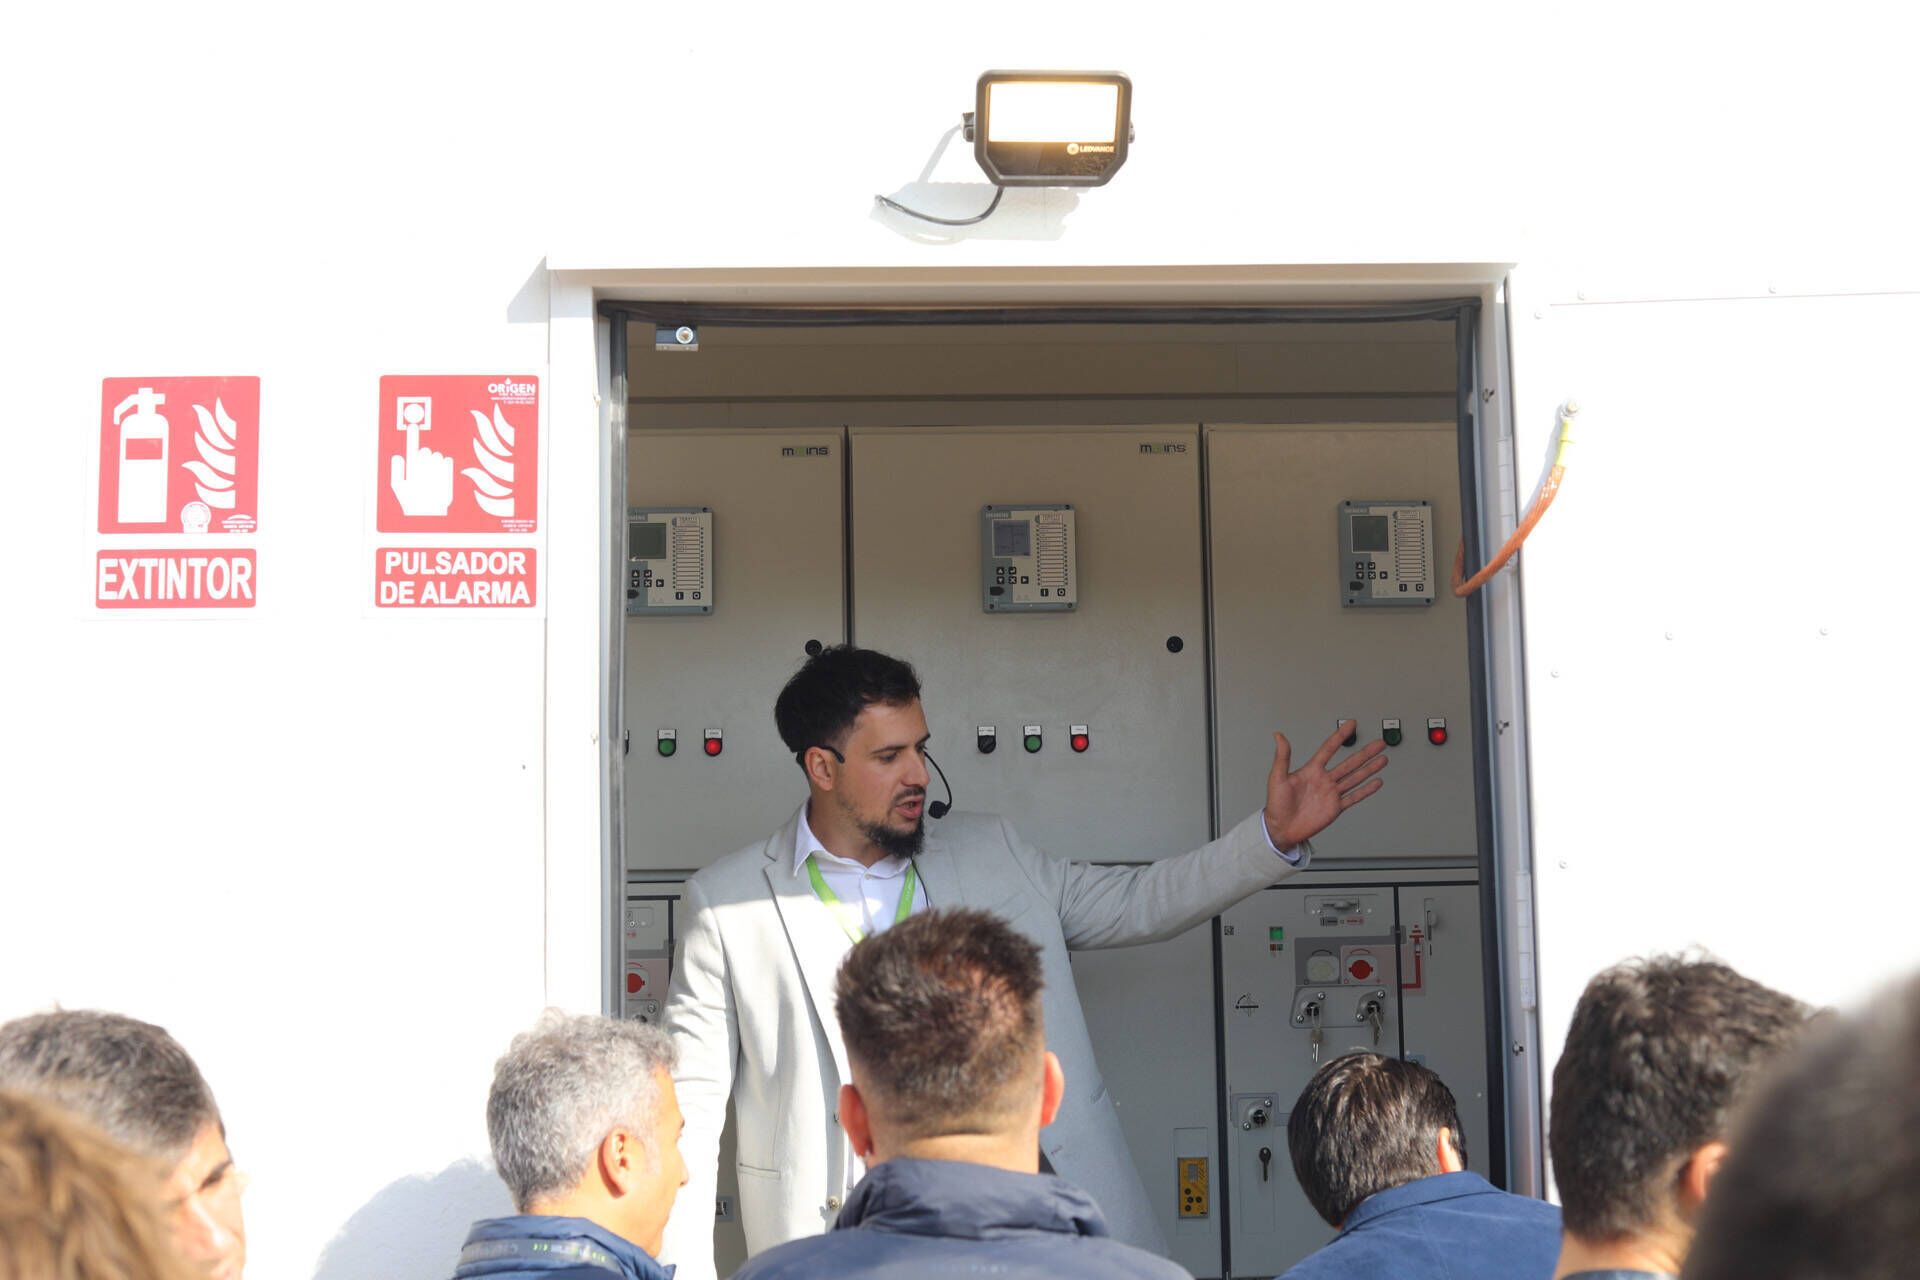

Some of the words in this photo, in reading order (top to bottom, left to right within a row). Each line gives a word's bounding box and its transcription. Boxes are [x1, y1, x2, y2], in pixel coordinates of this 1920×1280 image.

[1079, 145, 1115, 153] LEDVANCE
[384, 551, 527, 576] PULSADOR
[98, 556, 254, 601] EXTINTOR
[380, 580, 415, 605] DE
[420, 580, 531, 605] ALARMA
